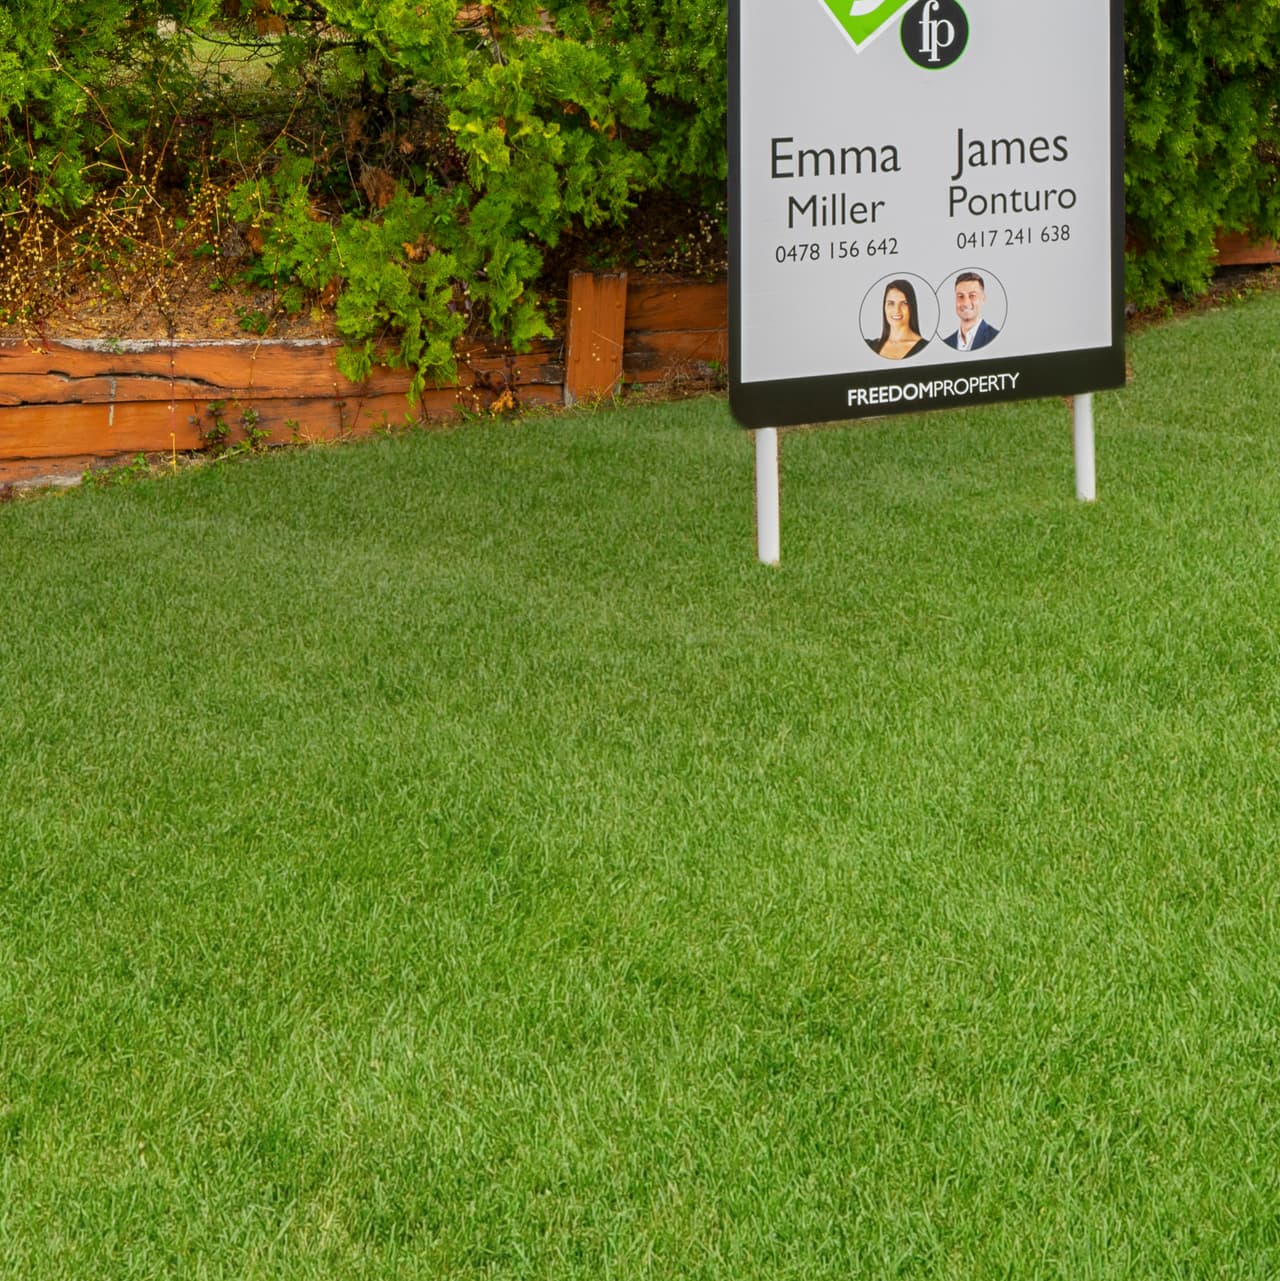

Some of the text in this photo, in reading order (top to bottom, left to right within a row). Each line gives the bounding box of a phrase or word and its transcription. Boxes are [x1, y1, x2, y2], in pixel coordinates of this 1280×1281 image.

[770, 136, 901, 178] Emma
[951, 128, 1069, 181] James
[788, 193, 885, 228] Miller
[949, 185, 1077, 218] Ponturo
[775, 238, 899, 263] 0478 156 642
[956, 224, 1071, 249] 0417 241 638
